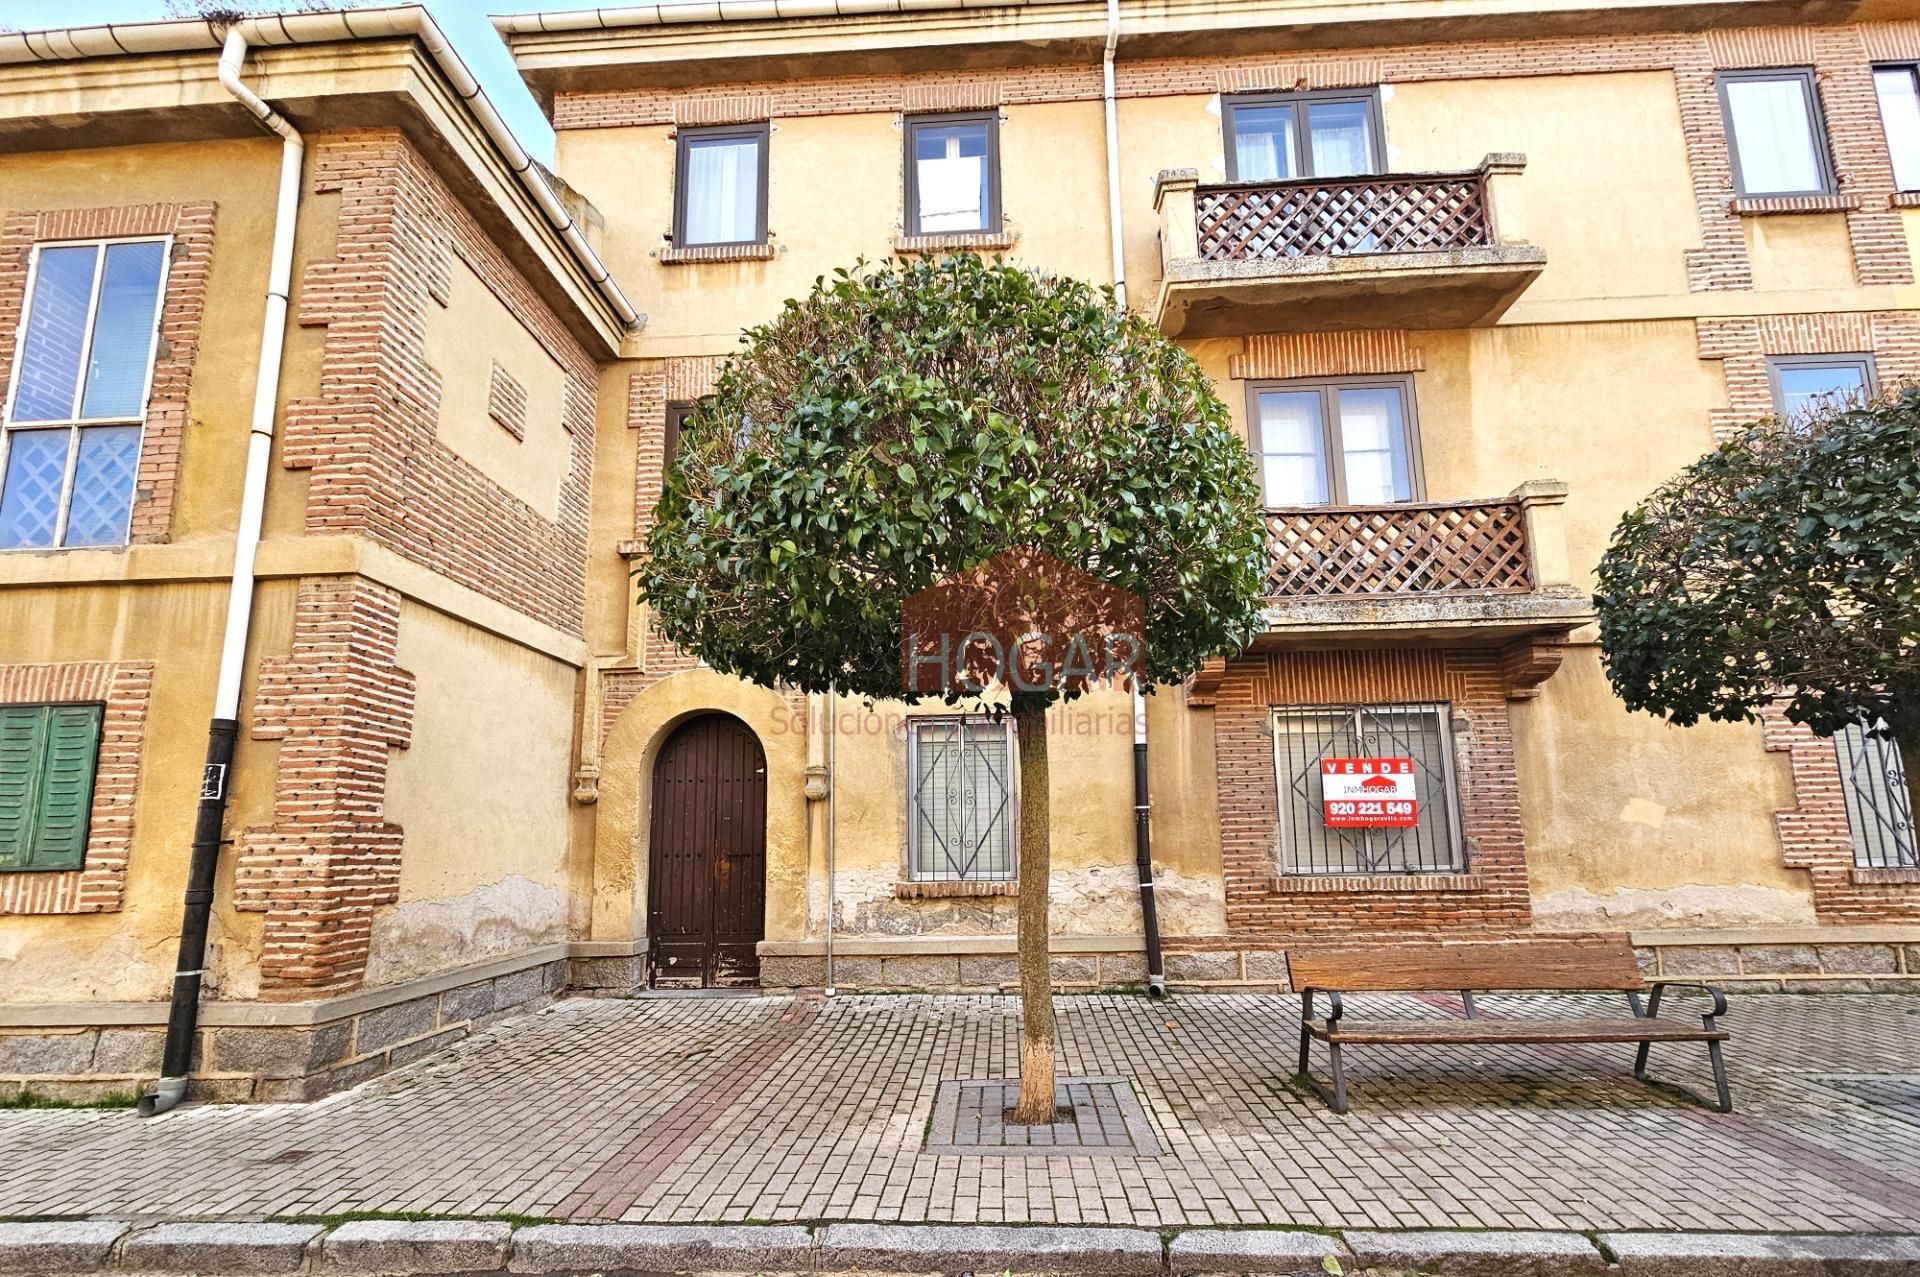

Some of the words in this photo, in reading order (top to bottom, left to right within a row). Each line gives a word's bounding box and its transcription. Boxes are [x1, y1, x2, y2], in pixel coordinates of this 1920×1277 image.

[1327, 763, 1409, 774] VENDE
[1329, 802, 1355, 815] 920
[1358, 802, 1384, 815] 221
[1386, 802, 1412, 815] 549
